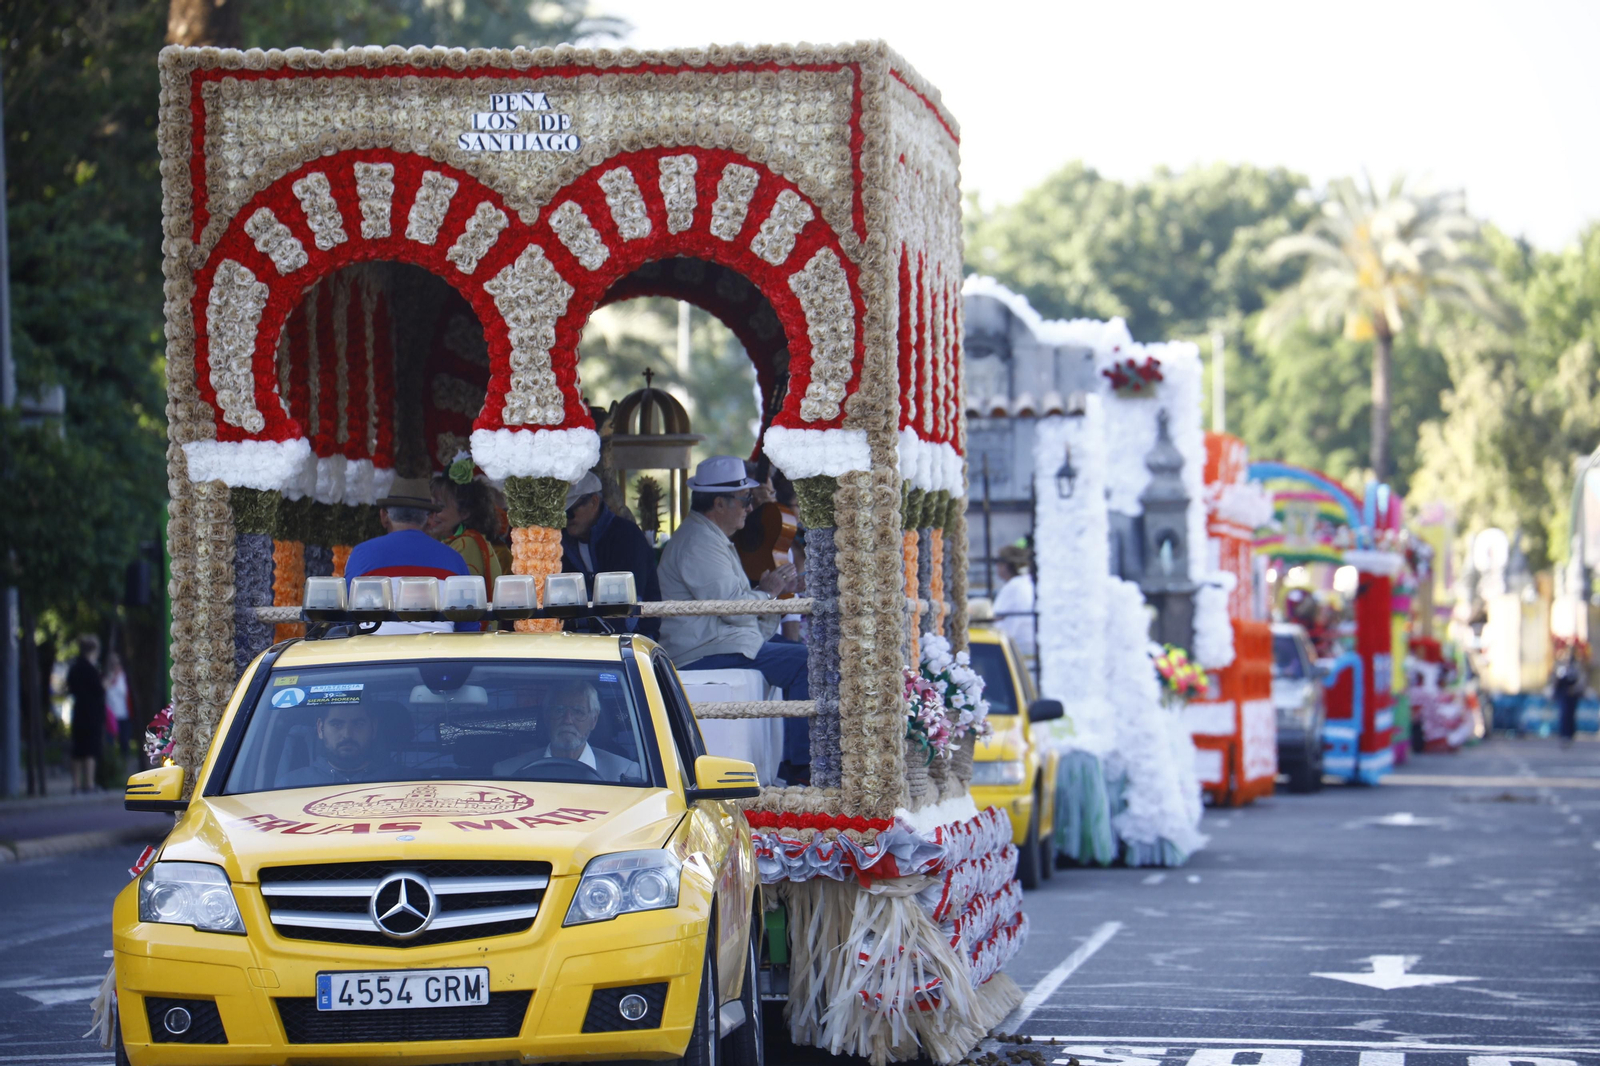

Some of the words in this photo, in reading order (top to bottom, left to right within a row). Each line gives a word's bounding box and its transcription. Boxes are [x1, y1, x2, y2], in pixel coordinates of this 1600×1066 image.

[491, 89, 552, 111] PEÑA
[473, 113, 518, 130] LOS
[540, 114, 572, 131] DE
[458, 133, 581, 151] SANTIAGO
[449, 807, 612, 831] MATA
[321, 996, 329, 1004] E
[338, 977, 413, 1006] 4554
[425, 974, 481, 1003] GRM
